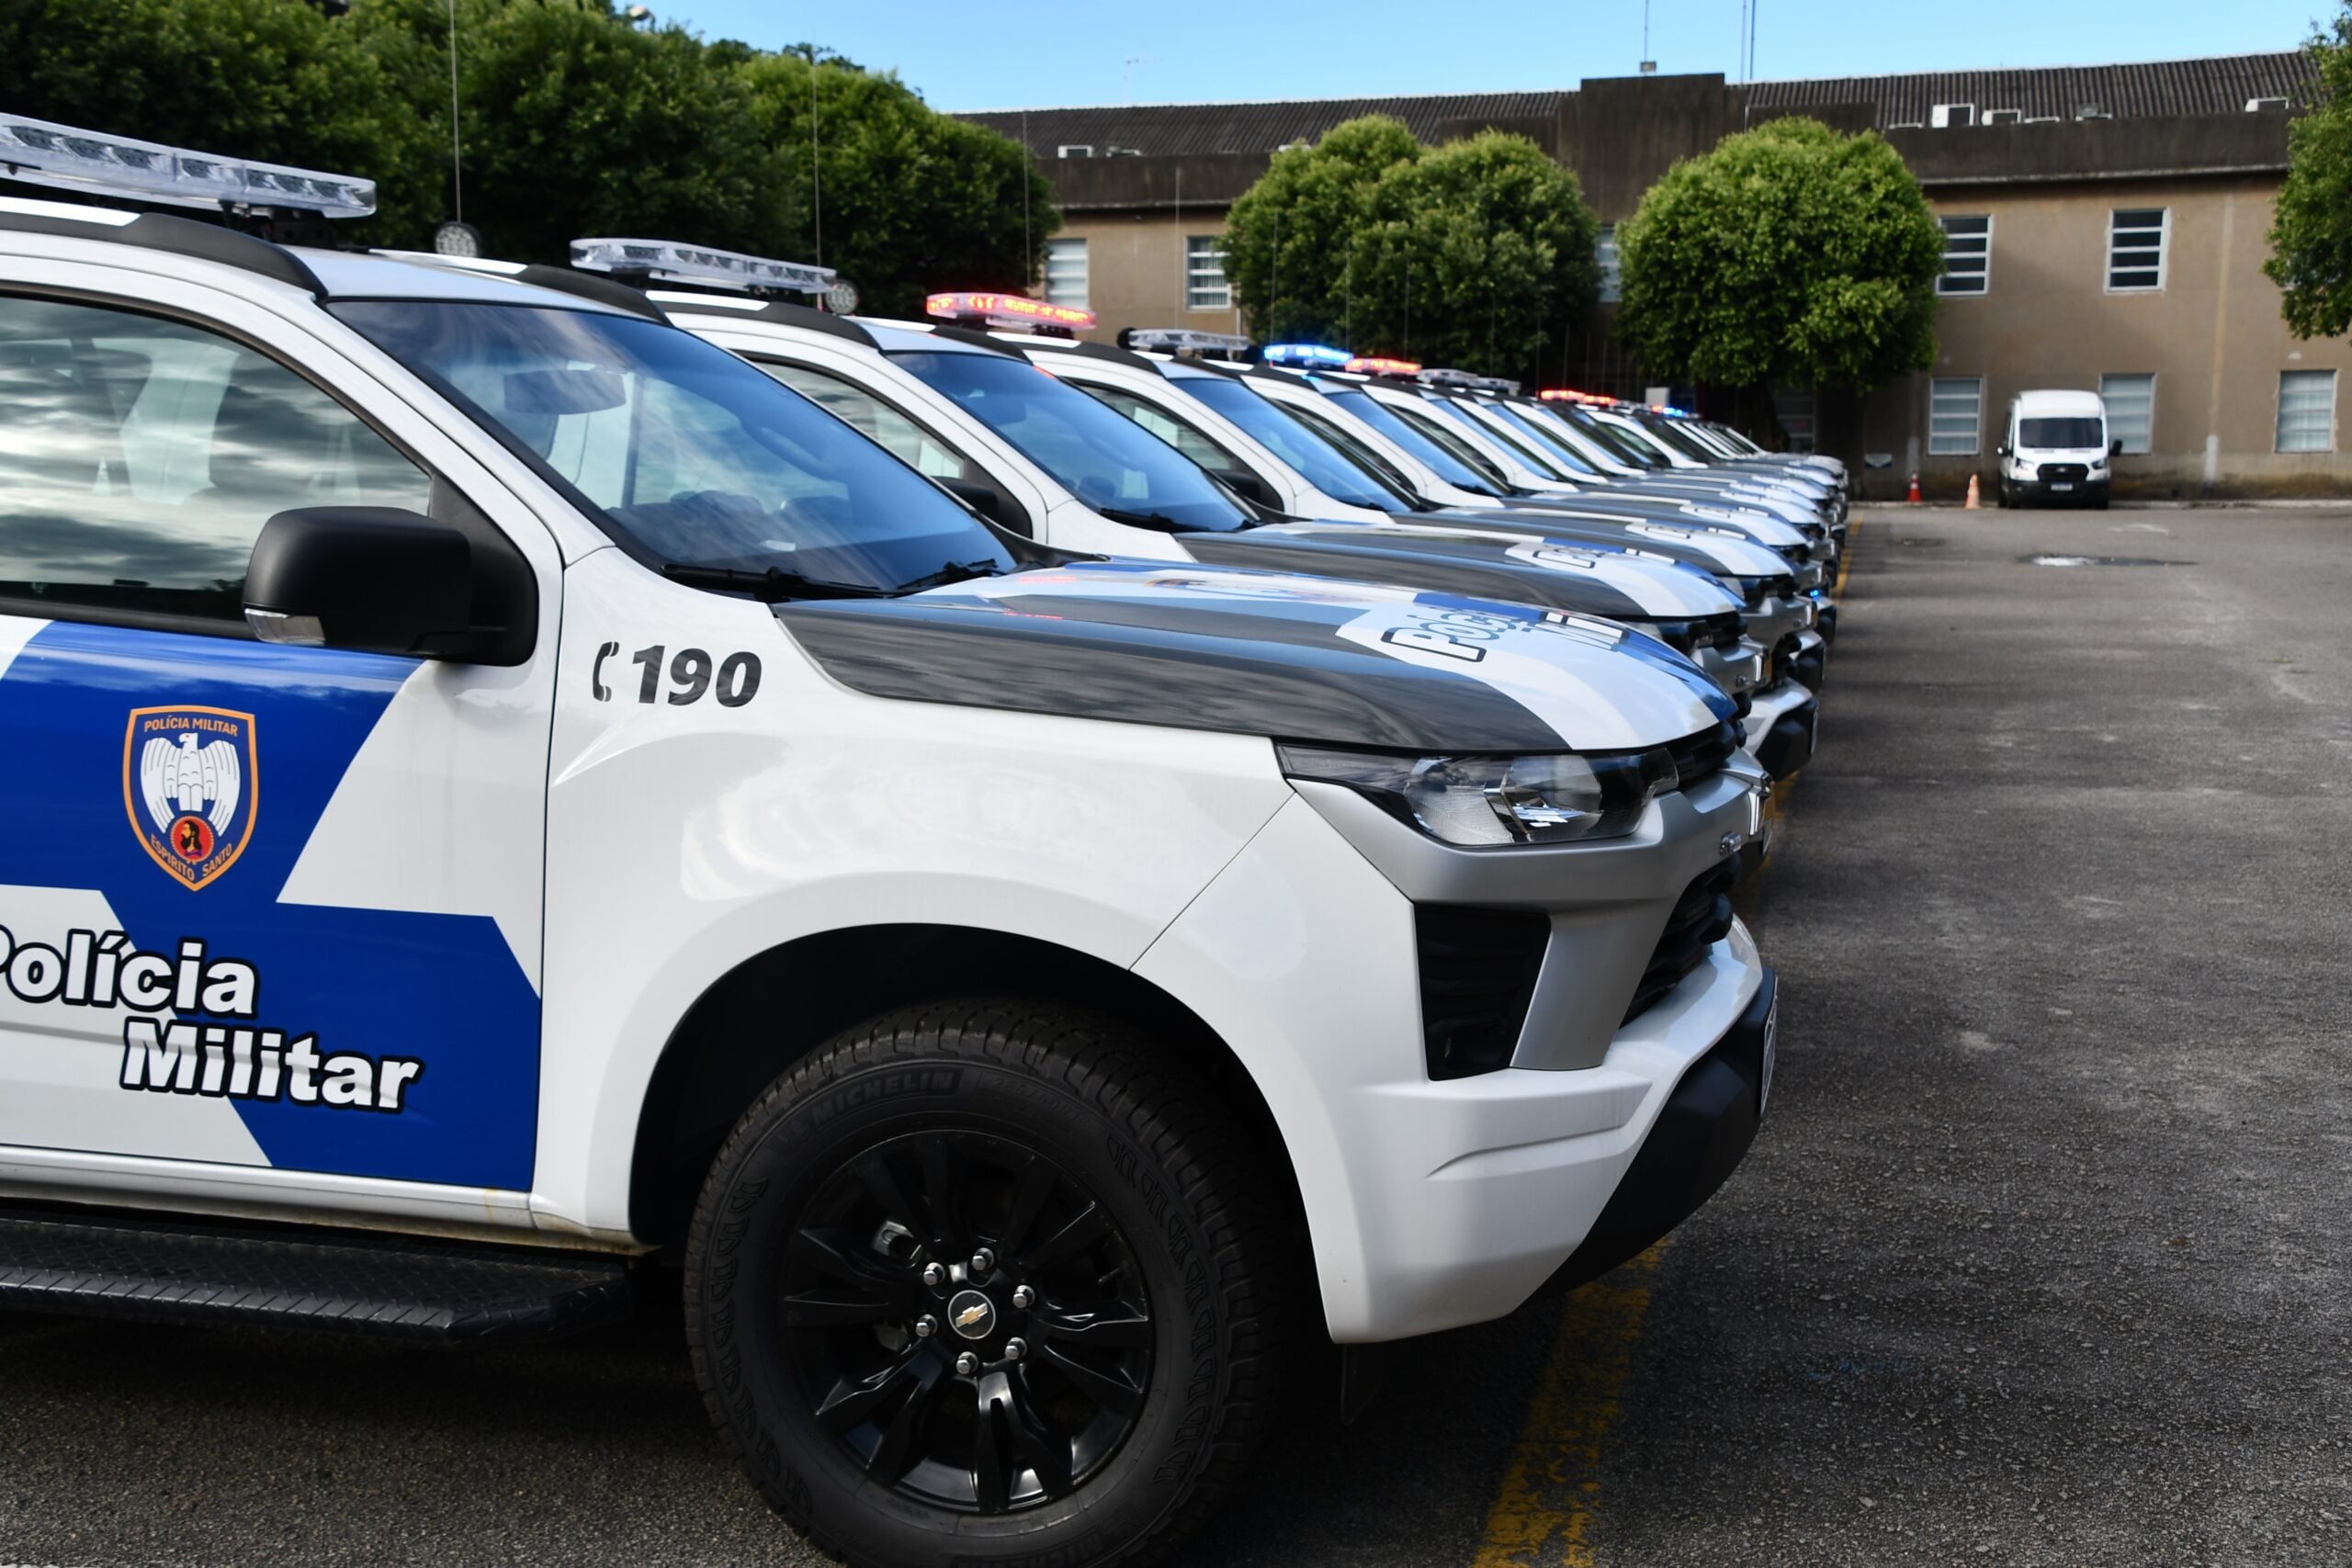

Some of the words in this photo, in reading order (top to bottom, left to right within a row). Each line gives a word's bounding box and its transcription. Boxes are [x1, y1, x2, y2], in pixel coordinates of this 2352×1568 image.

[632, 645, 762, 707] 190
[144, 715, 189, 732] POLÍCIA
[192, 717, 238, 737] MILITAR
[202, 842, 232, 877] SANTO
[0, 924, 258, 1020] olícia
[119, 1016, 425, 1114] Militar
[812, 1072, 956, 1125] MICHELIN
